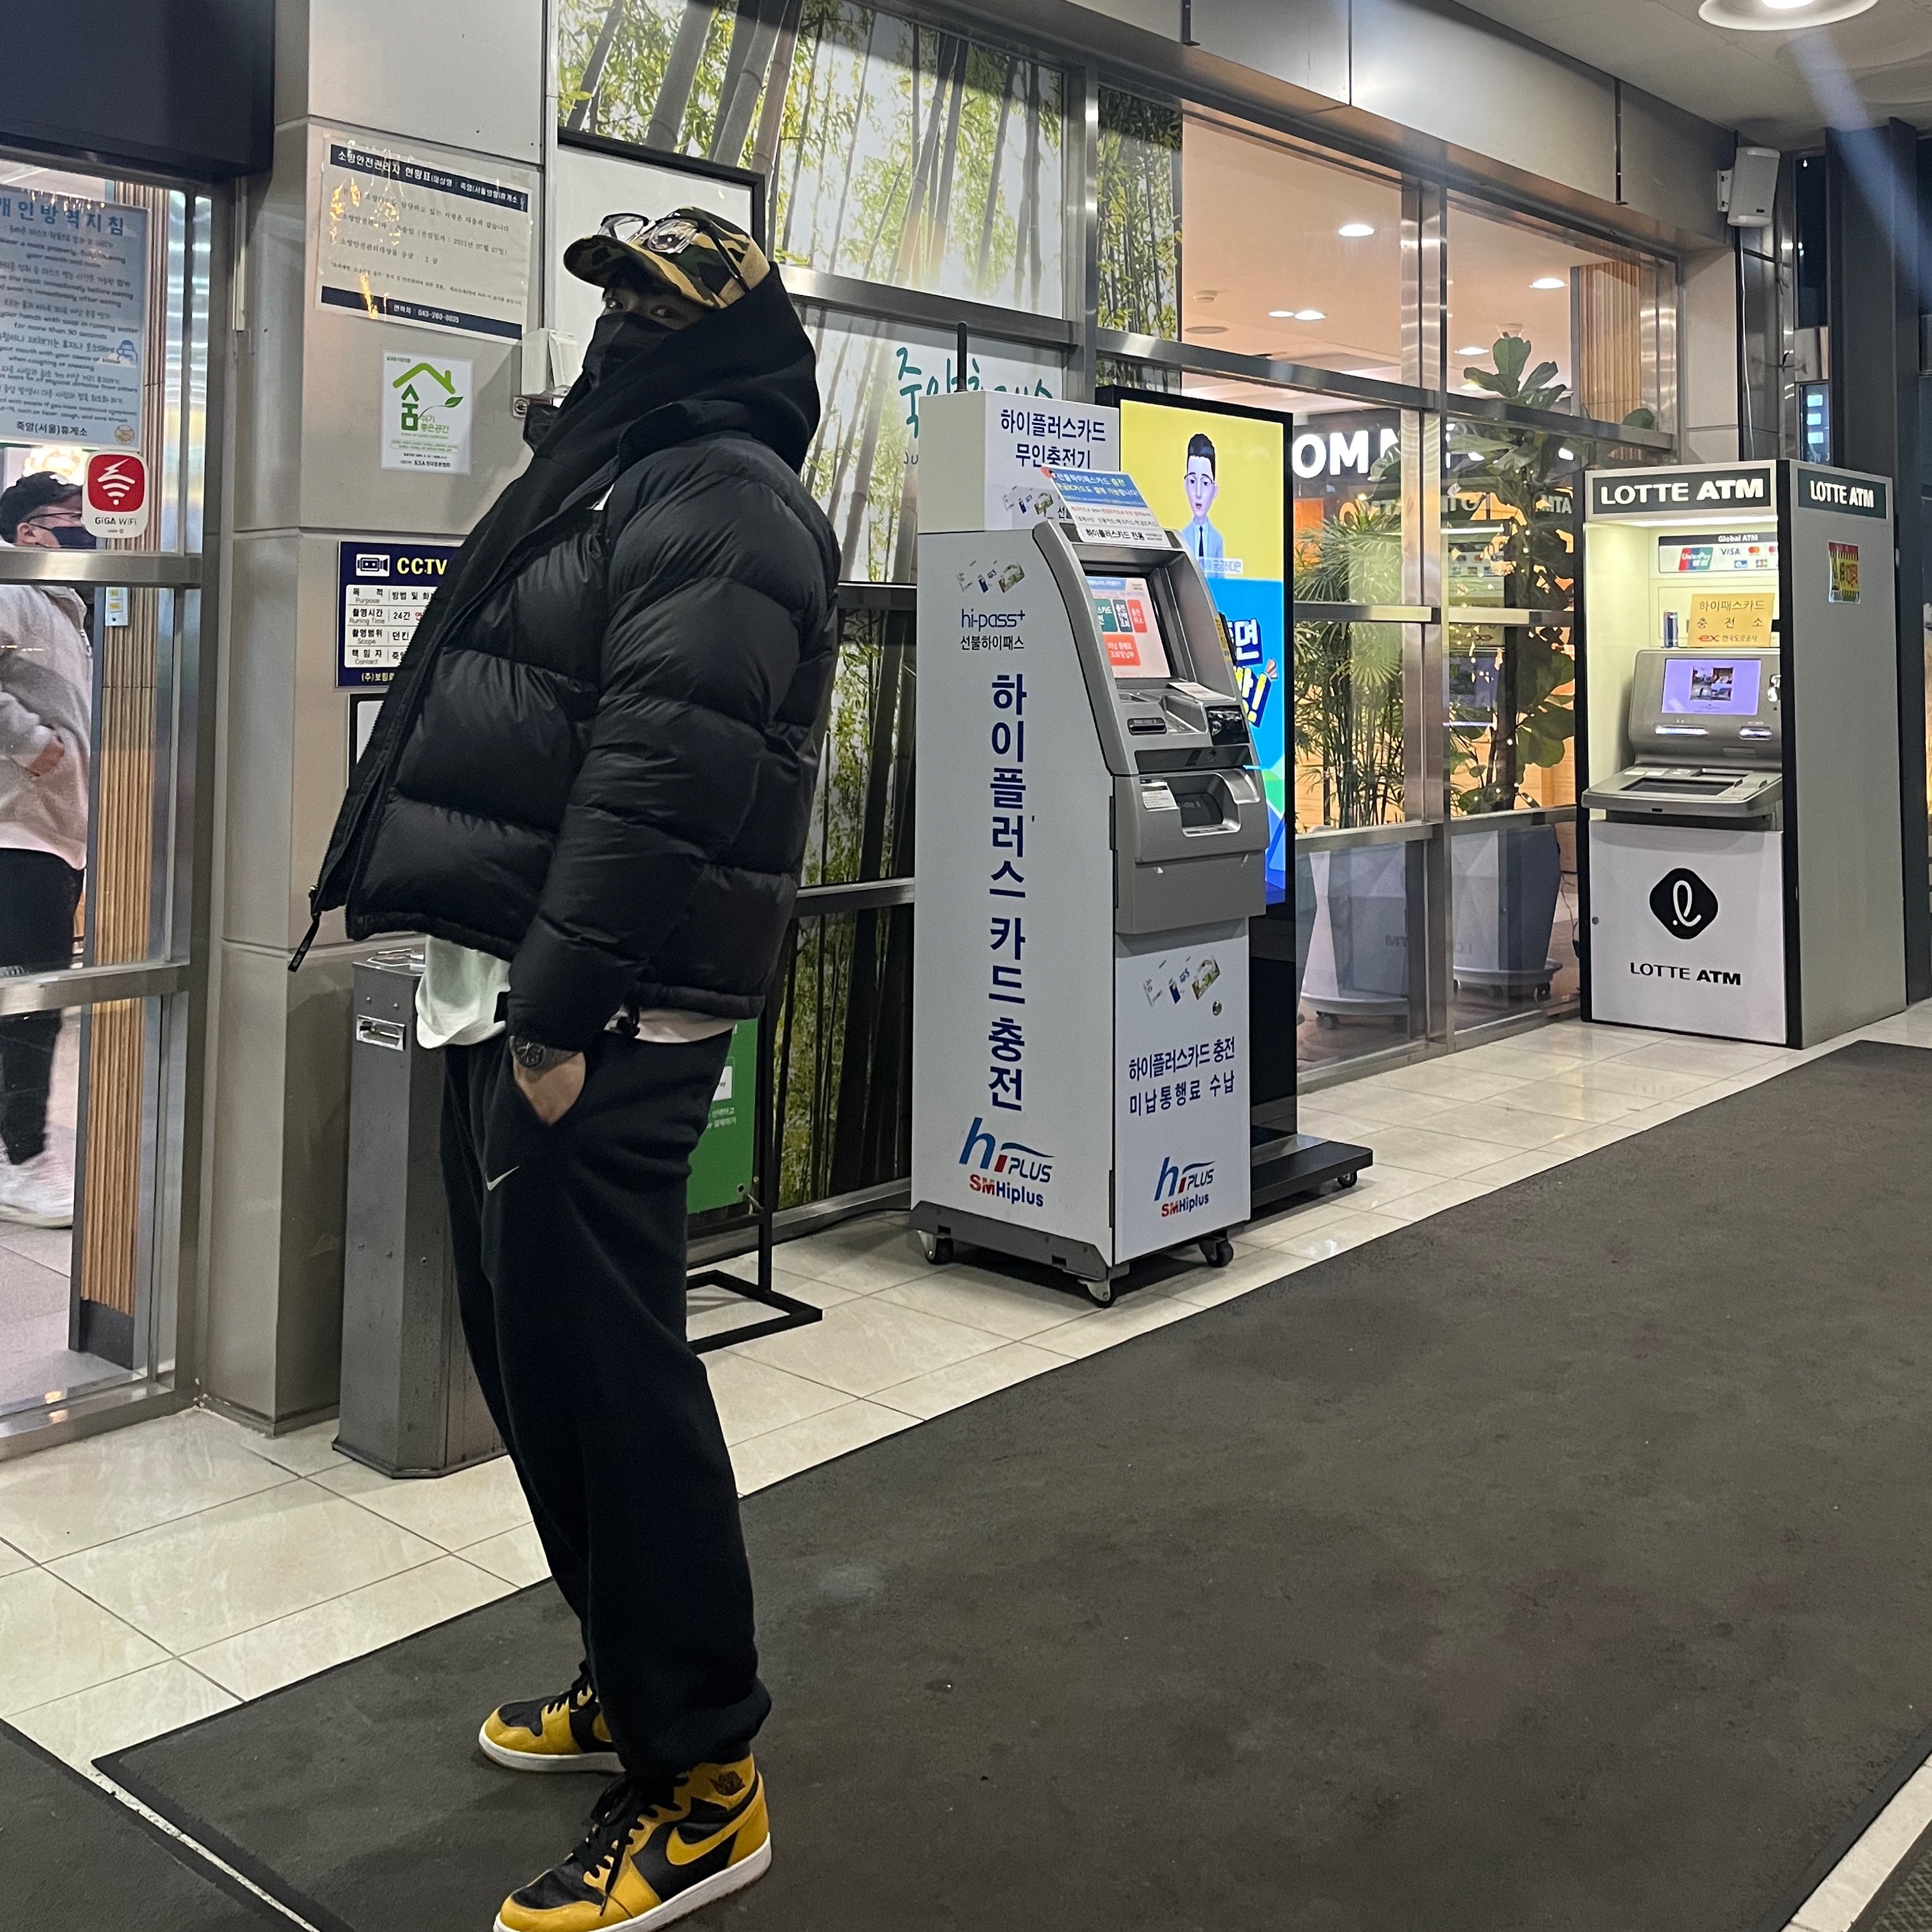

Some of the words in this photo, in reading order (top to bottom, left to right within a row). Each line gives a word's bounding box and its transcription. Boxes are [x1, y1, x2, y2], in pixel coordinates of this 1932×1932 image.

[17, 420, 88, 437] 죽암(서울)휴게소
[1001, 409, 1107, 442] 하이플러스카드
[1015, 443, 1091, 470] 무인충전기
[1600, 482, 1690, 506] LOTTE
[1696, 478, 1765, 500] ATM
[1810, 480, 1848, 505] LOTTE
[1849, 486, 1875, 509] ATM
[1718, 534, 1741, 543] Global
[1742, 534, 1759, 542] ATM
[397, 557, 448, 575] CCTV
[353, 608, 383, 617] 촬영시간
[1699, 600, 1766, 612] 하이패스카드
[960, 635, 1024, 650] 선불하이패스
[1630, 962, 1690, 980] LOTTE
[1696, 969, 1741, 986] ATM
[1128, 1043, 1211, 1082] 하이플러스카드
[1213, 1035, 1236, 1061] 충전
[1129, 1079, 1201, 1117] 미납통행료
[1209, 1069, 1236, 1095] 수납
